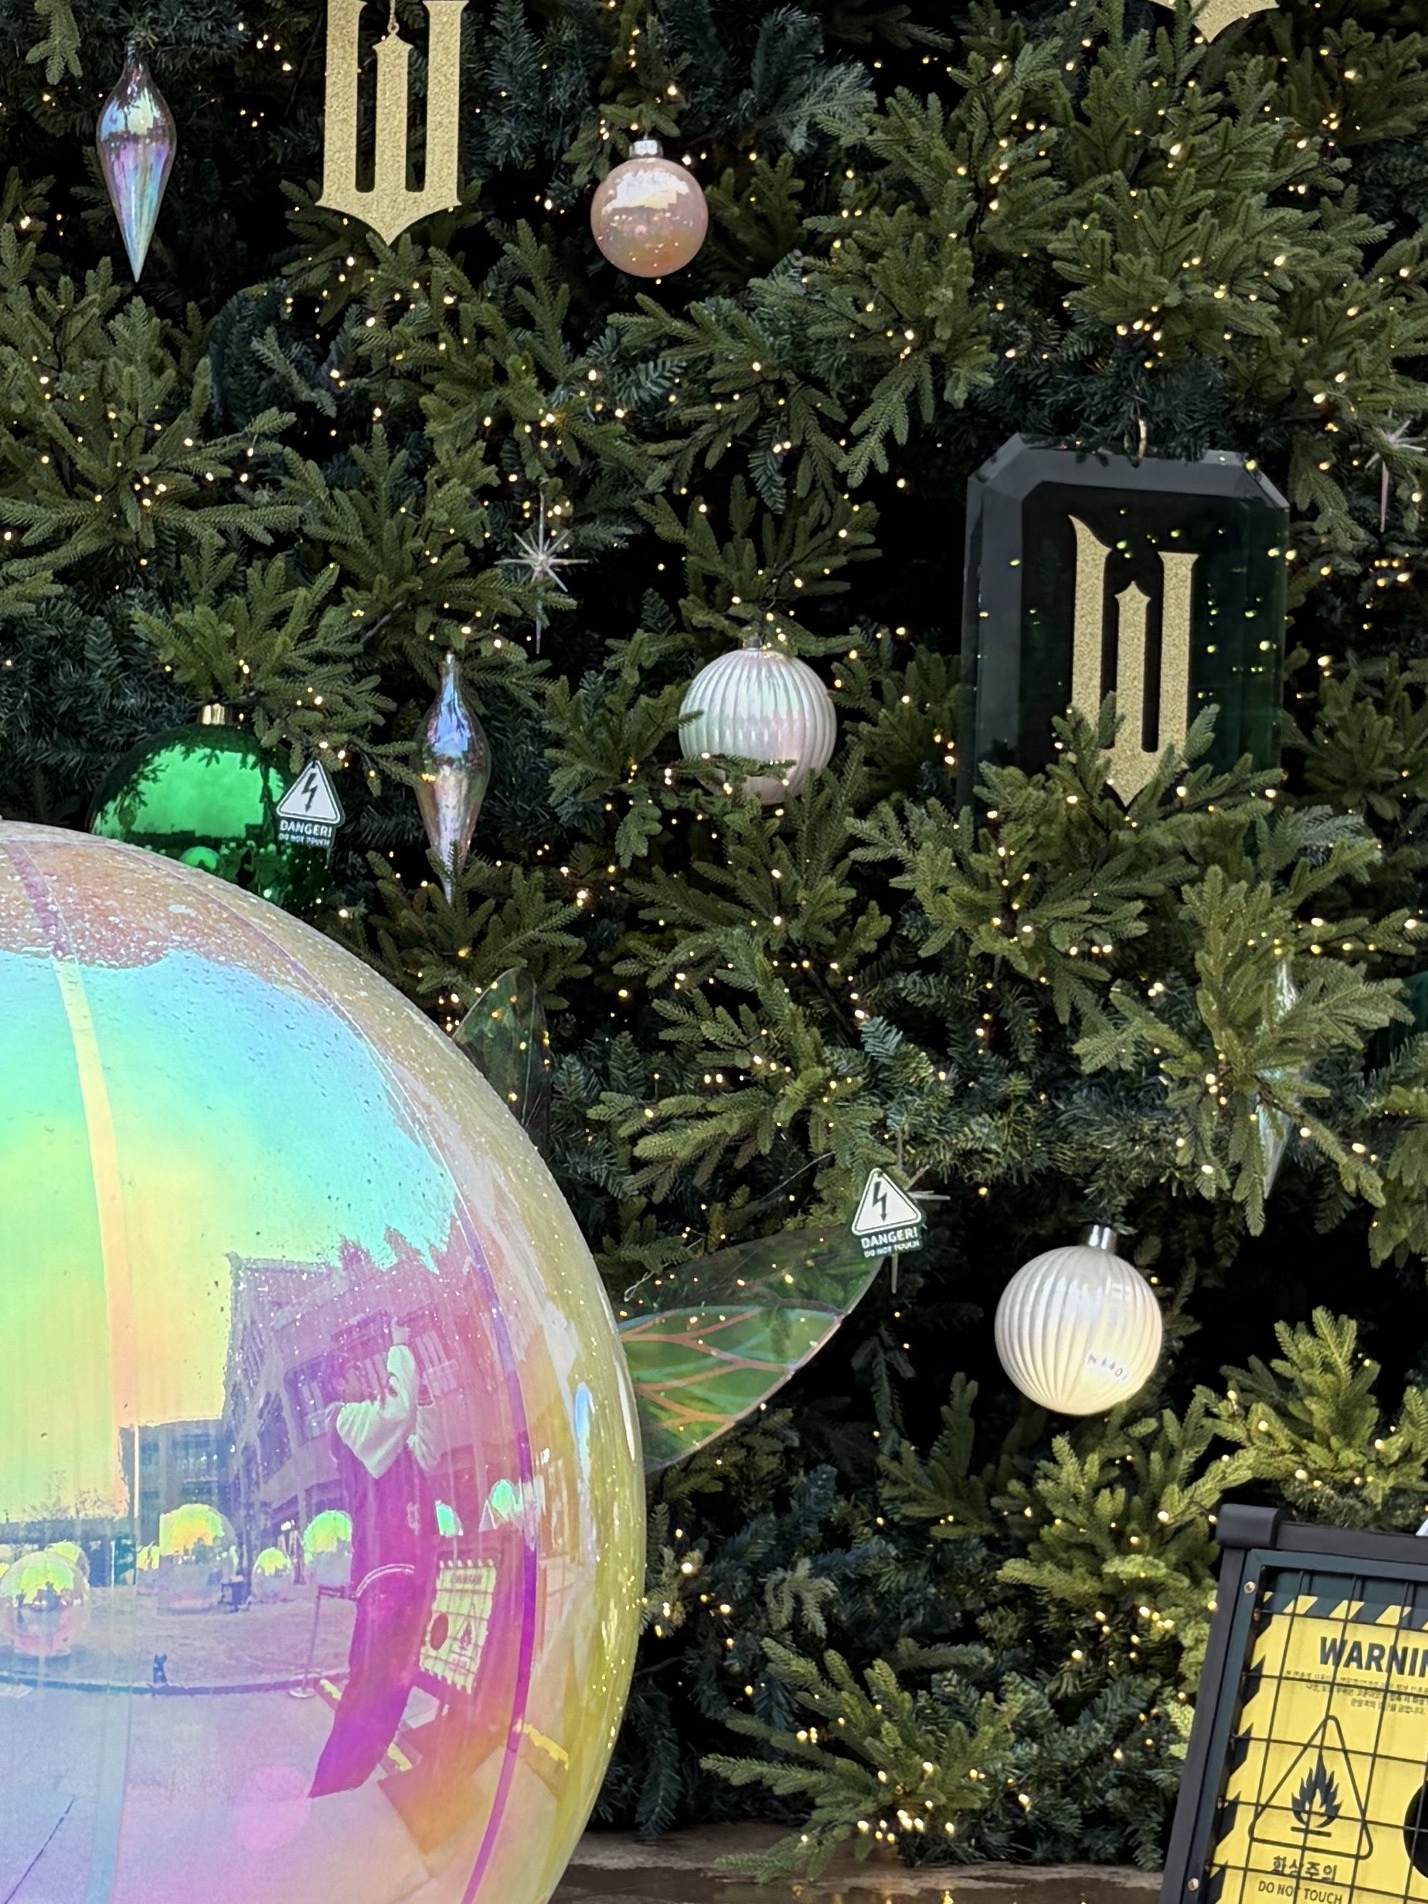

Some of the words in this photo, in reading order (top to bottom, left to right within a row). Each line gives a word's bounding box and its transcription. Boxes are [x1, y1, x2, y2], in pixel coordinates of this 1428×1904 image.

[861, 1226, 918, 1249] DANGER!
[1258, 1880, 1275, 1893] DO
[1303, 1888, 1343, 1904] TOUCH
